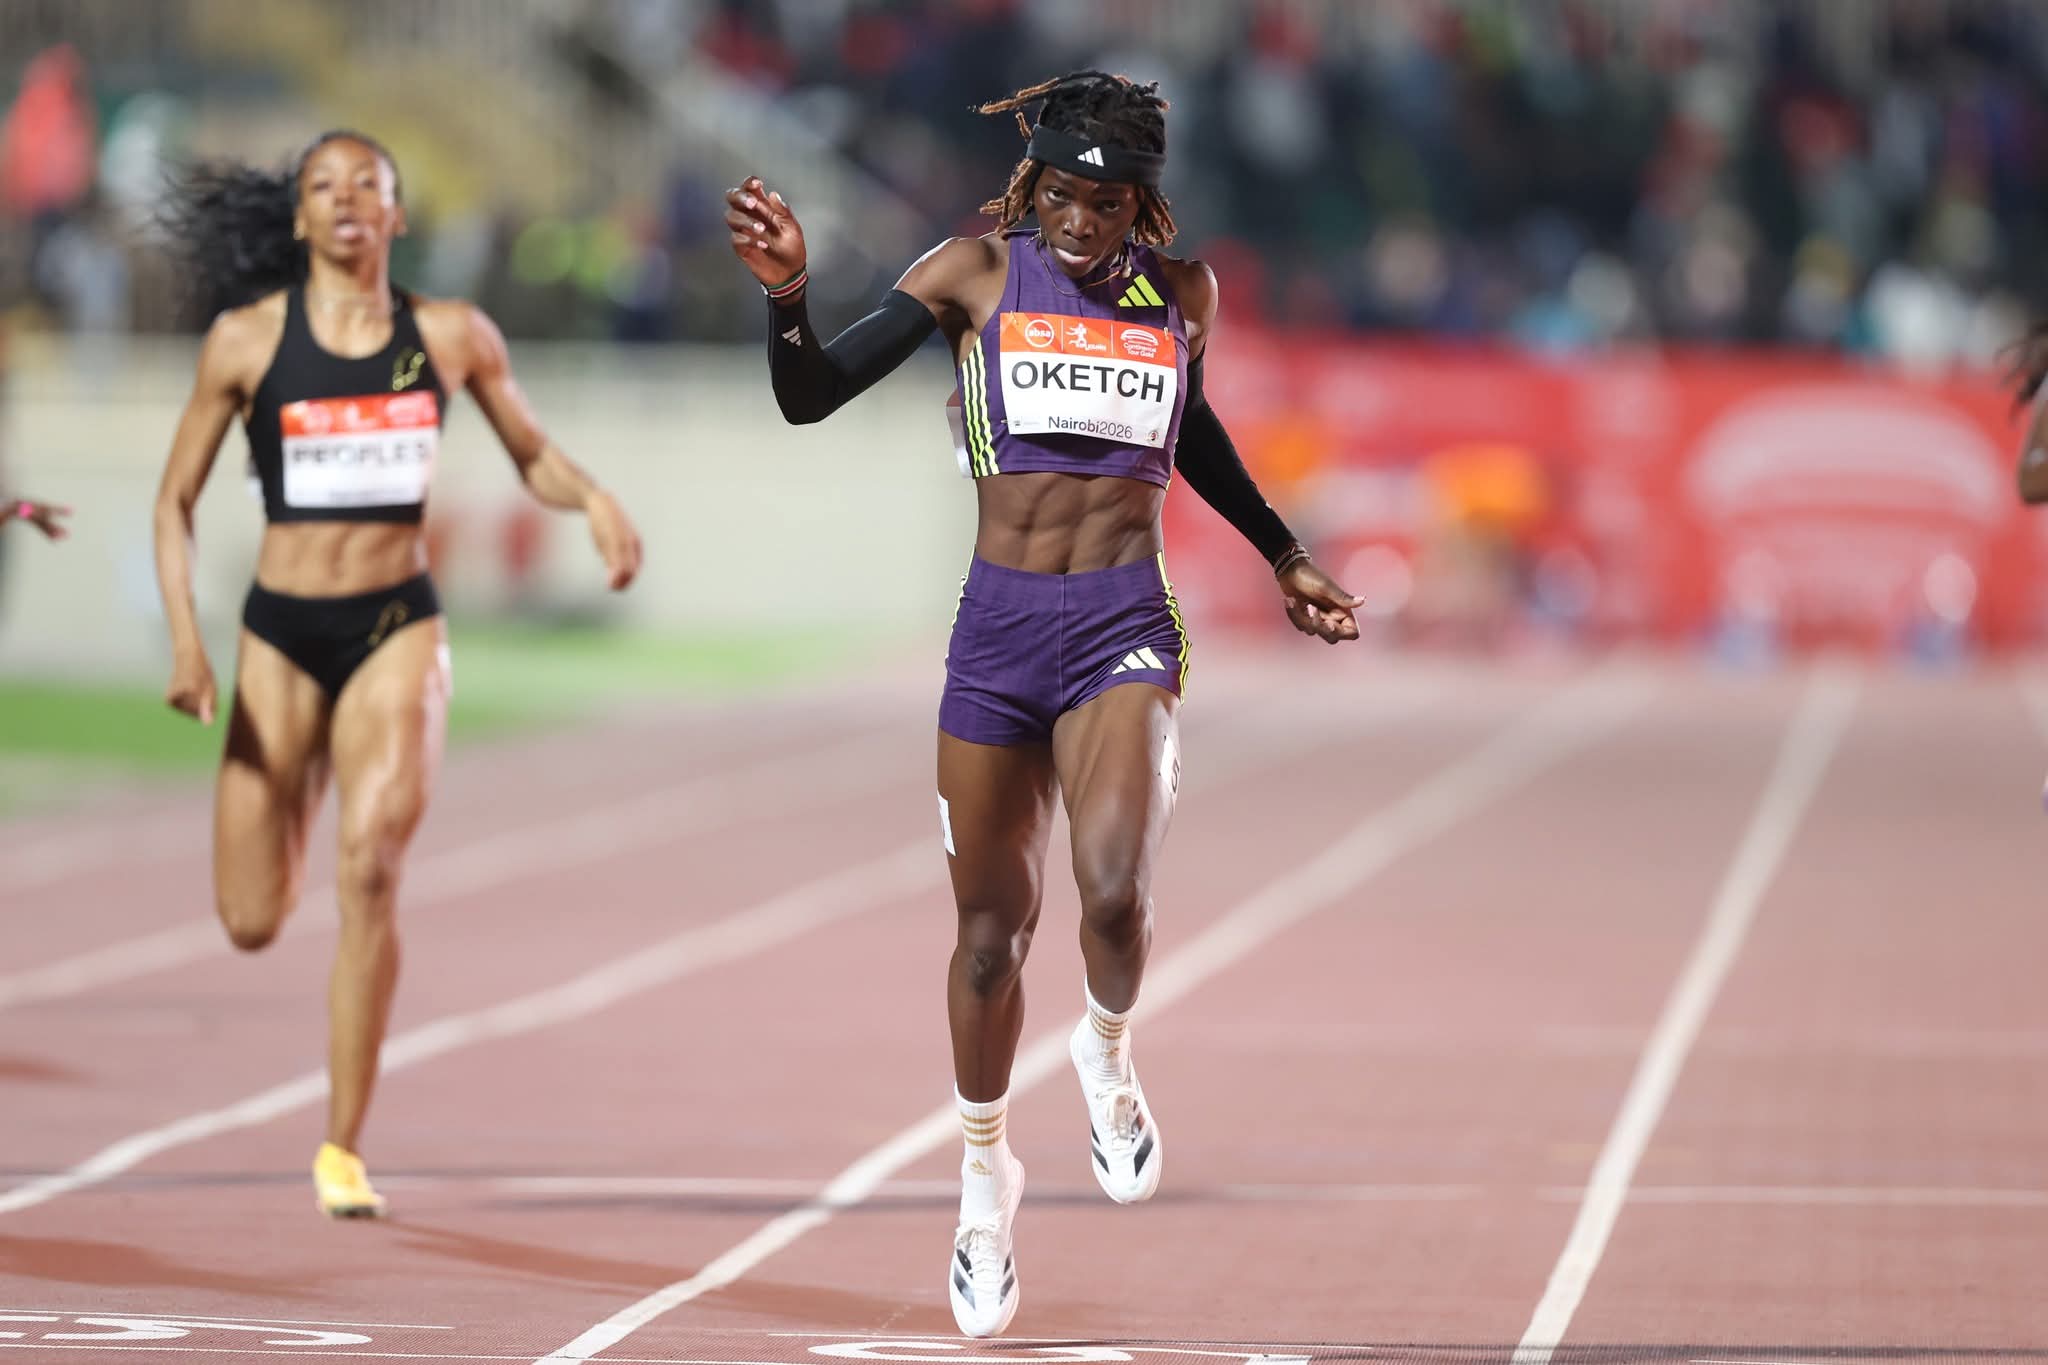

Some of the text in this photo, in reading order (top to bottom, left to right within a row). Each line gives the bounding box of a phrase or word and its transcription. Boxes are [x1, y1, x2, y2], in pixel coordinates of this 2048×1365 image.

[1029, 327, 1051, 338] absa
[1140, 350, 1154, 358] Gold
[1011, 360, 1165, 403] OKETCH
[1048, 415, 1134, 440] Nairobi2026
[1171, 756, 1180, 794] 5
